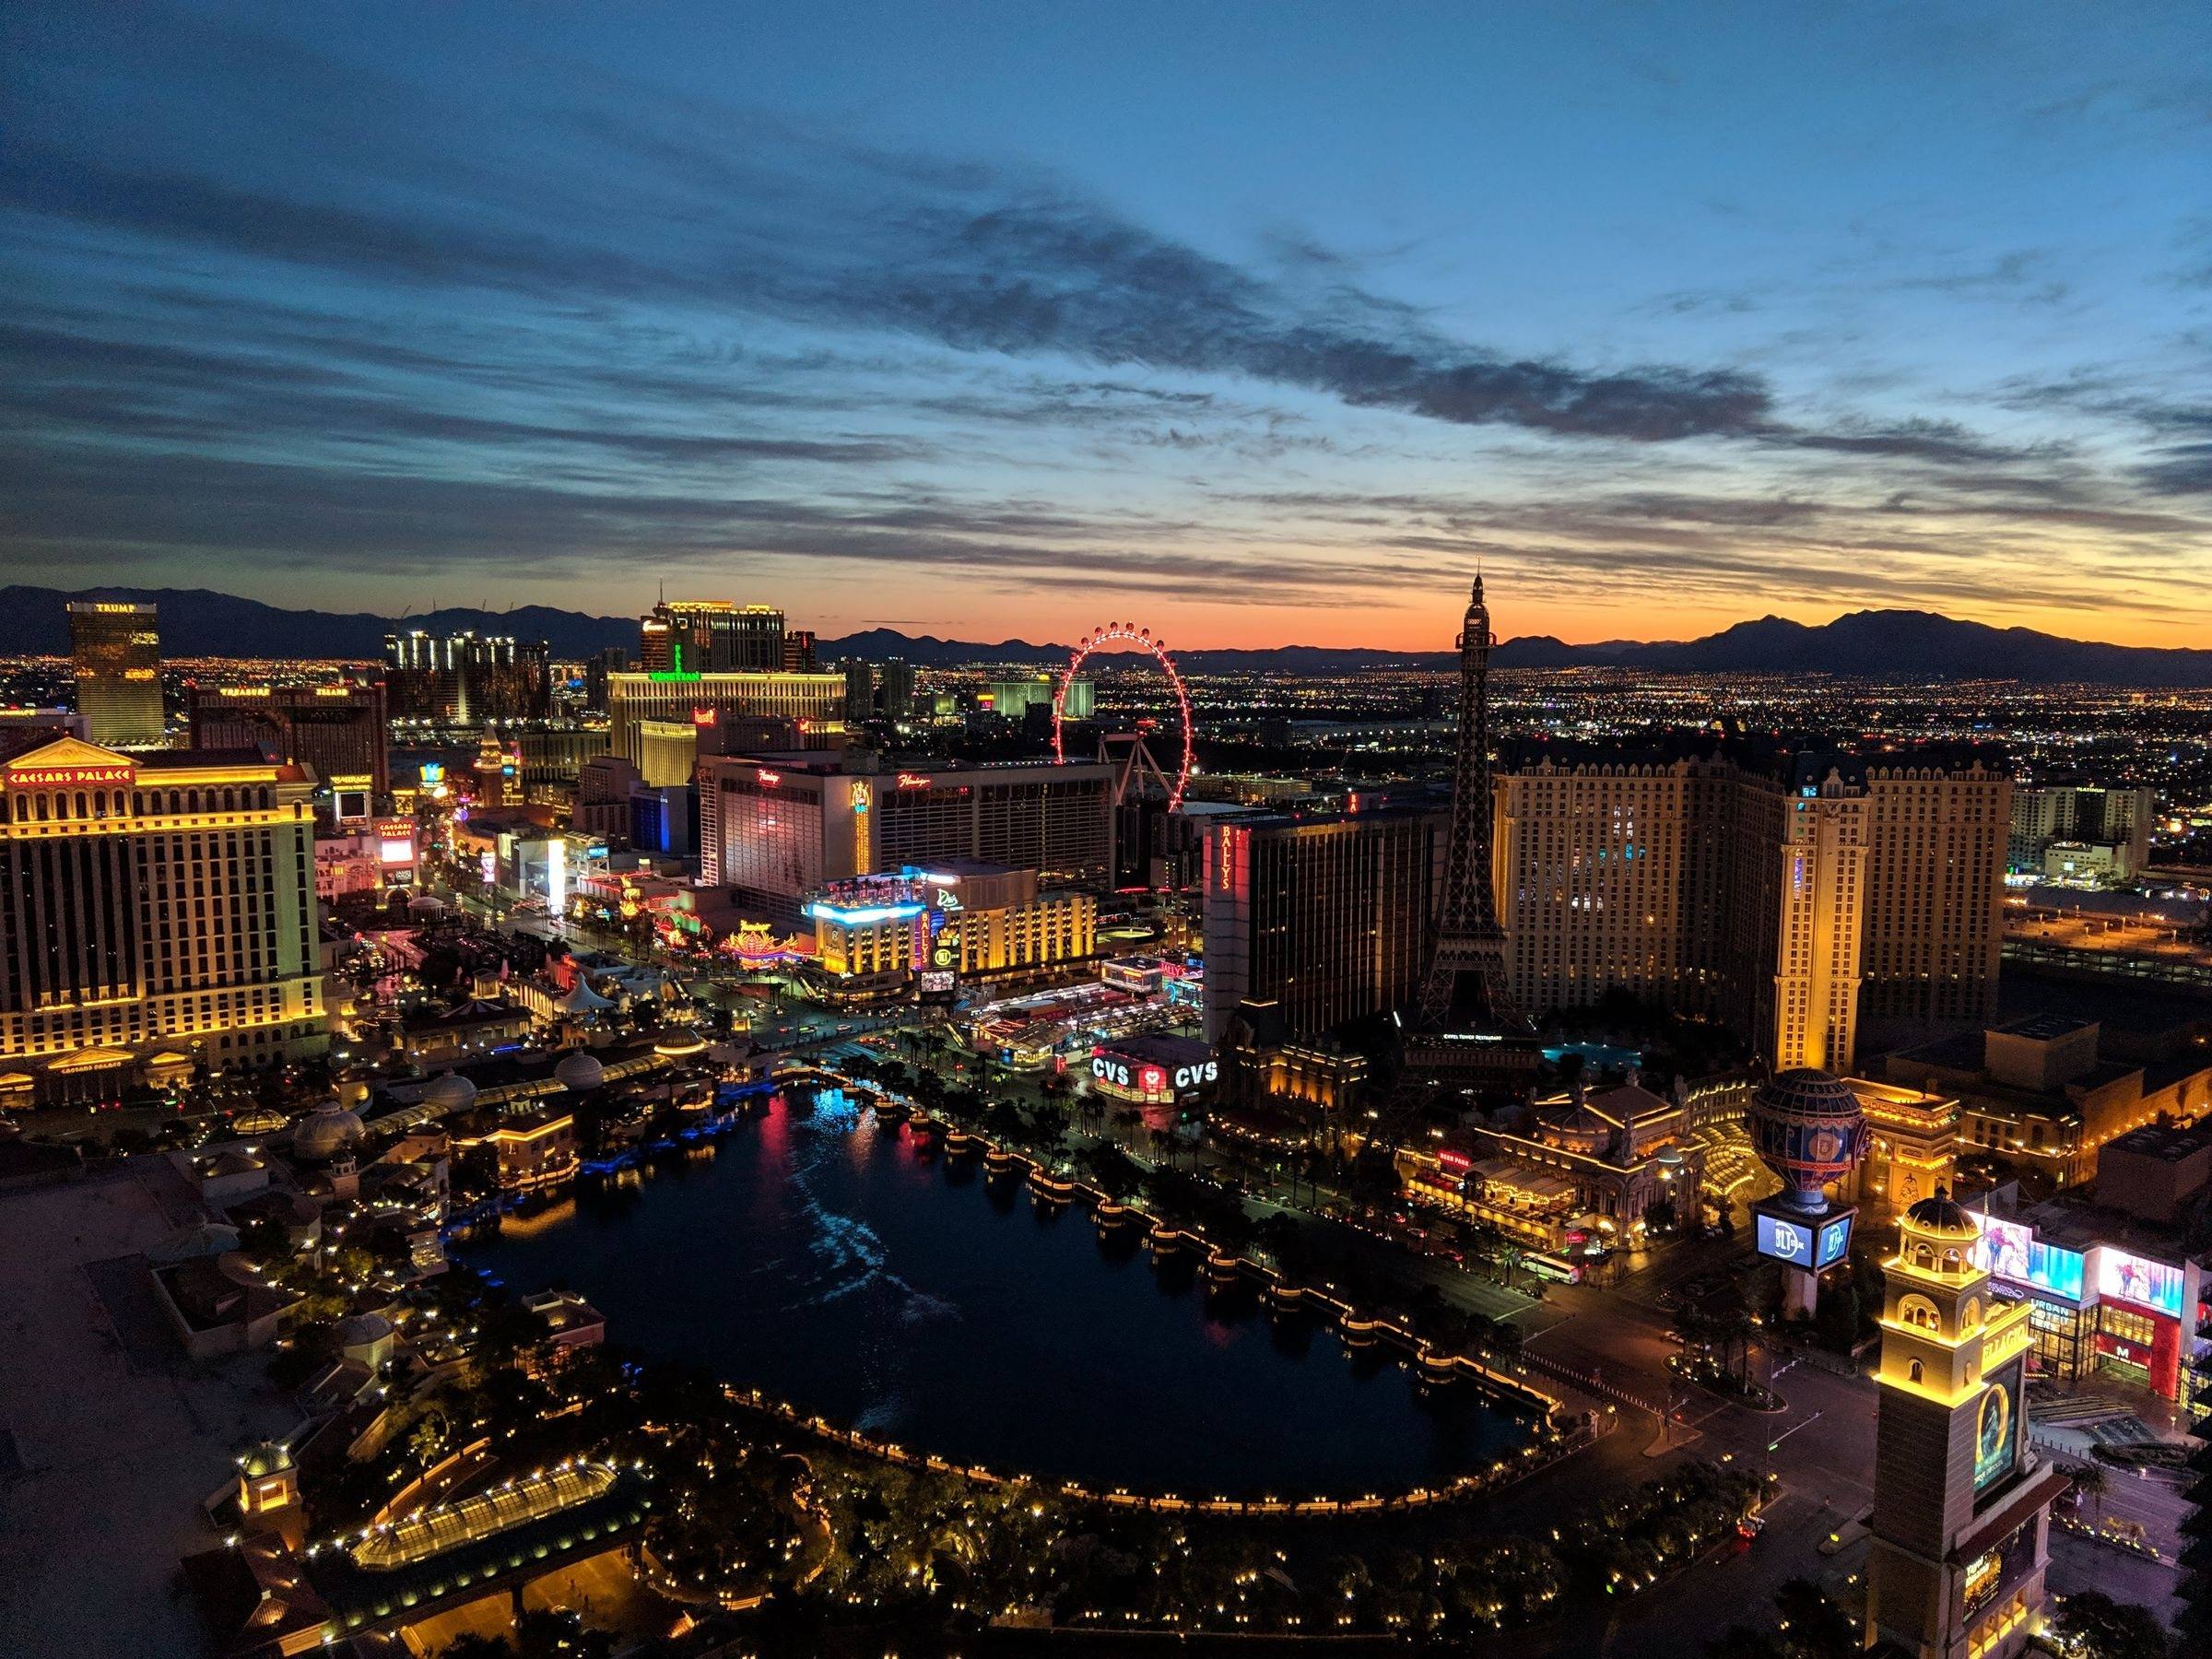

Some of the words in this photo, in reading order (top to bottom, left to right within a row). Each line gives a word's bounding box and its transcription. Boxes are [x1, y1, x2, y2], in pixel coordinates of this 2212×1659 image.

[97, 604, 135, 613] TRUMP
[650, 672, 700, 681] VENETIAN
[220, 688, 270, 697] TREASURE
[9, 771, 72, 783] CAESARS
[76, 770, 130, 782] PALACE
[759, 769, 780, 785] Flamingo
[899, 773, 931, 788] Flamingo
[61, 1065, 93, 1075] CAESARS
[94, 1061, 122, 1070] PALACE
[1092, 1057, 1130, 1086] CVS
[1175, 1062, 1218, 1088] CVS
[1440, 1152, 1454, 1162] BEER
[1454, 1157, 1469, 1167] PARK
[1775, 1228, 1793, 1252] BLT
[2030, 1298, 2069, 1316] URBAN
[2116, 1346, 2129, 1359] M
